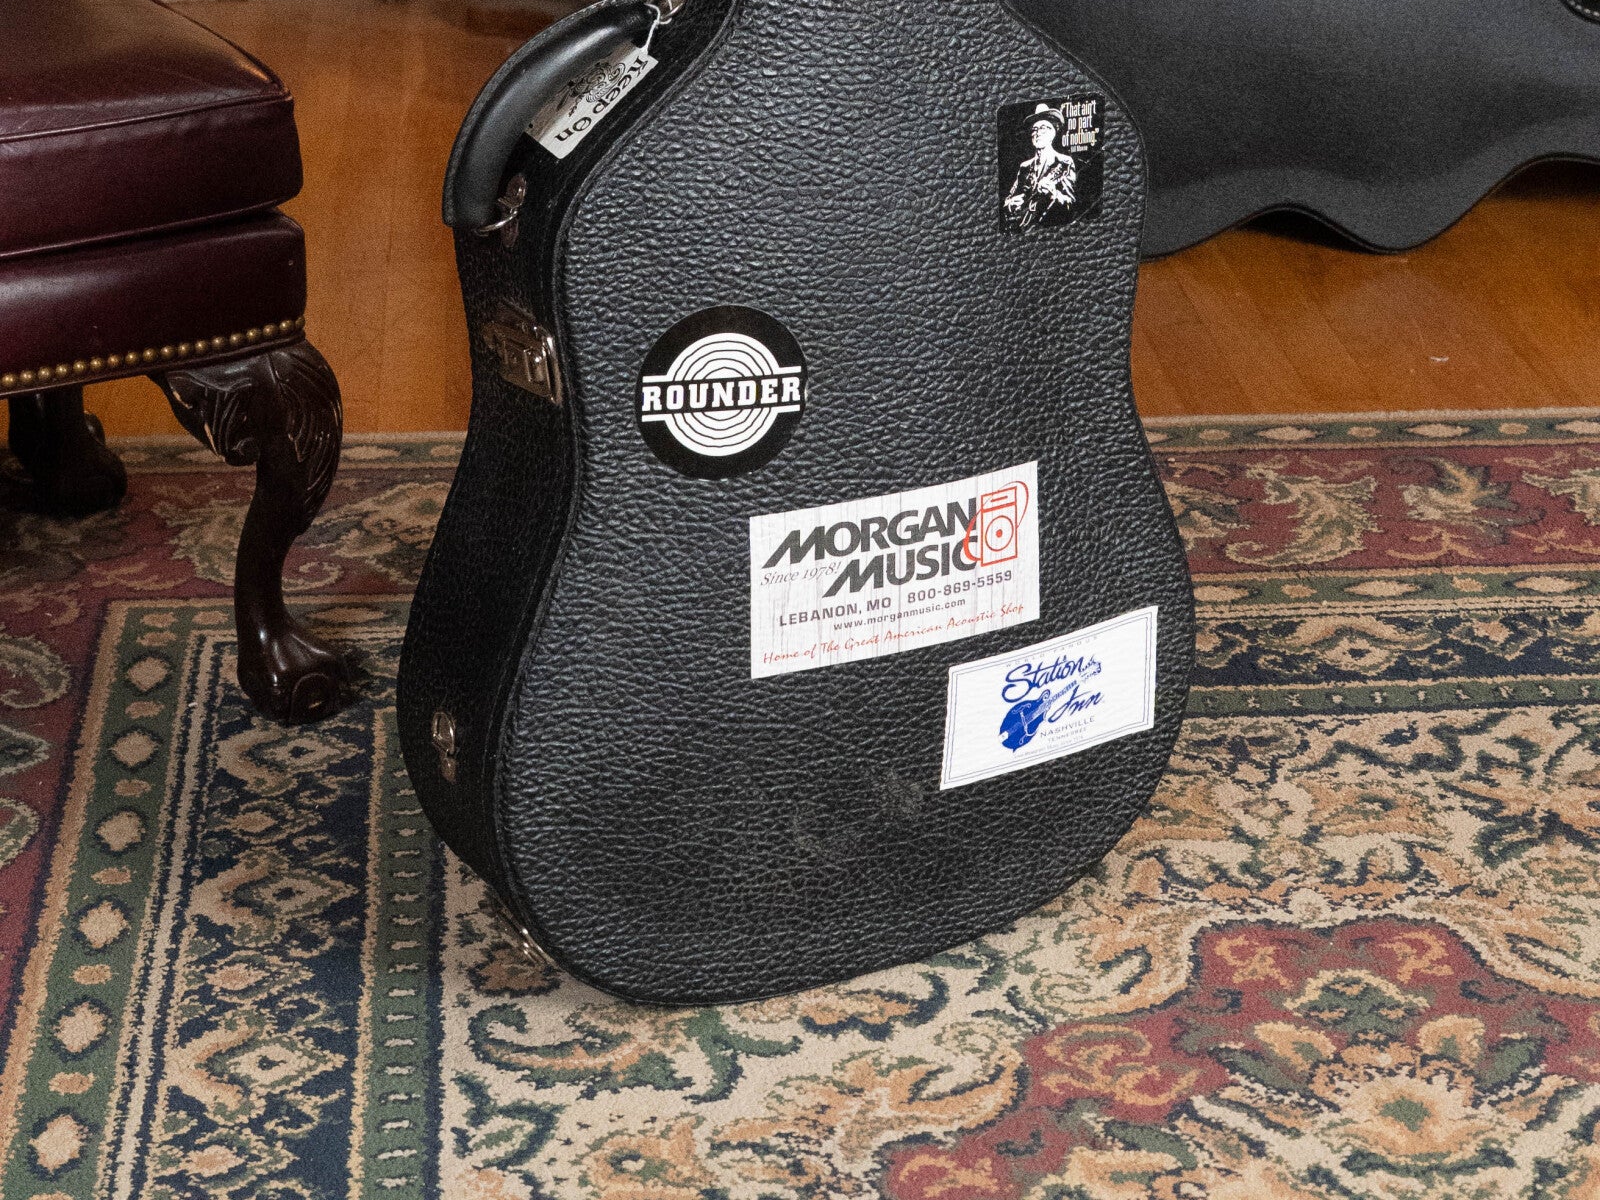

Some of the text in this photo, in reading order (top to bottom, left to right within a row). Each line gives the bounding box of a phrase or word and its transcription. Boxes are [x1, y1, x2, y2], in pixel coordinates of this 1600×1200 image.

[555, 55, 648, 142] Keep On
[1081, 100, 1097, 116] ain't
[1061, 131, 1069, 147] of
[1068, 115, 1093, 132] no part
[641, 376, 801, 412] ROUNDER
[761, 497, 978, 569] MORGAN
[760, 561, 842, 586] Since 1978!
[822, 535, 979, 599] MUSIC
[779, 570, 1012, 627] LEBANON, MO 800-869-5559
[834, 598, 966, 631] www.morganmusic.com
[763, 602, 1025, 664] Home of The Great American Acoustic Shop
[1001, 655, 1084, 703] Station
[1048, 685, 1102, 723] Inn
[1040, 716, 1095, 738] NASHVILLE
